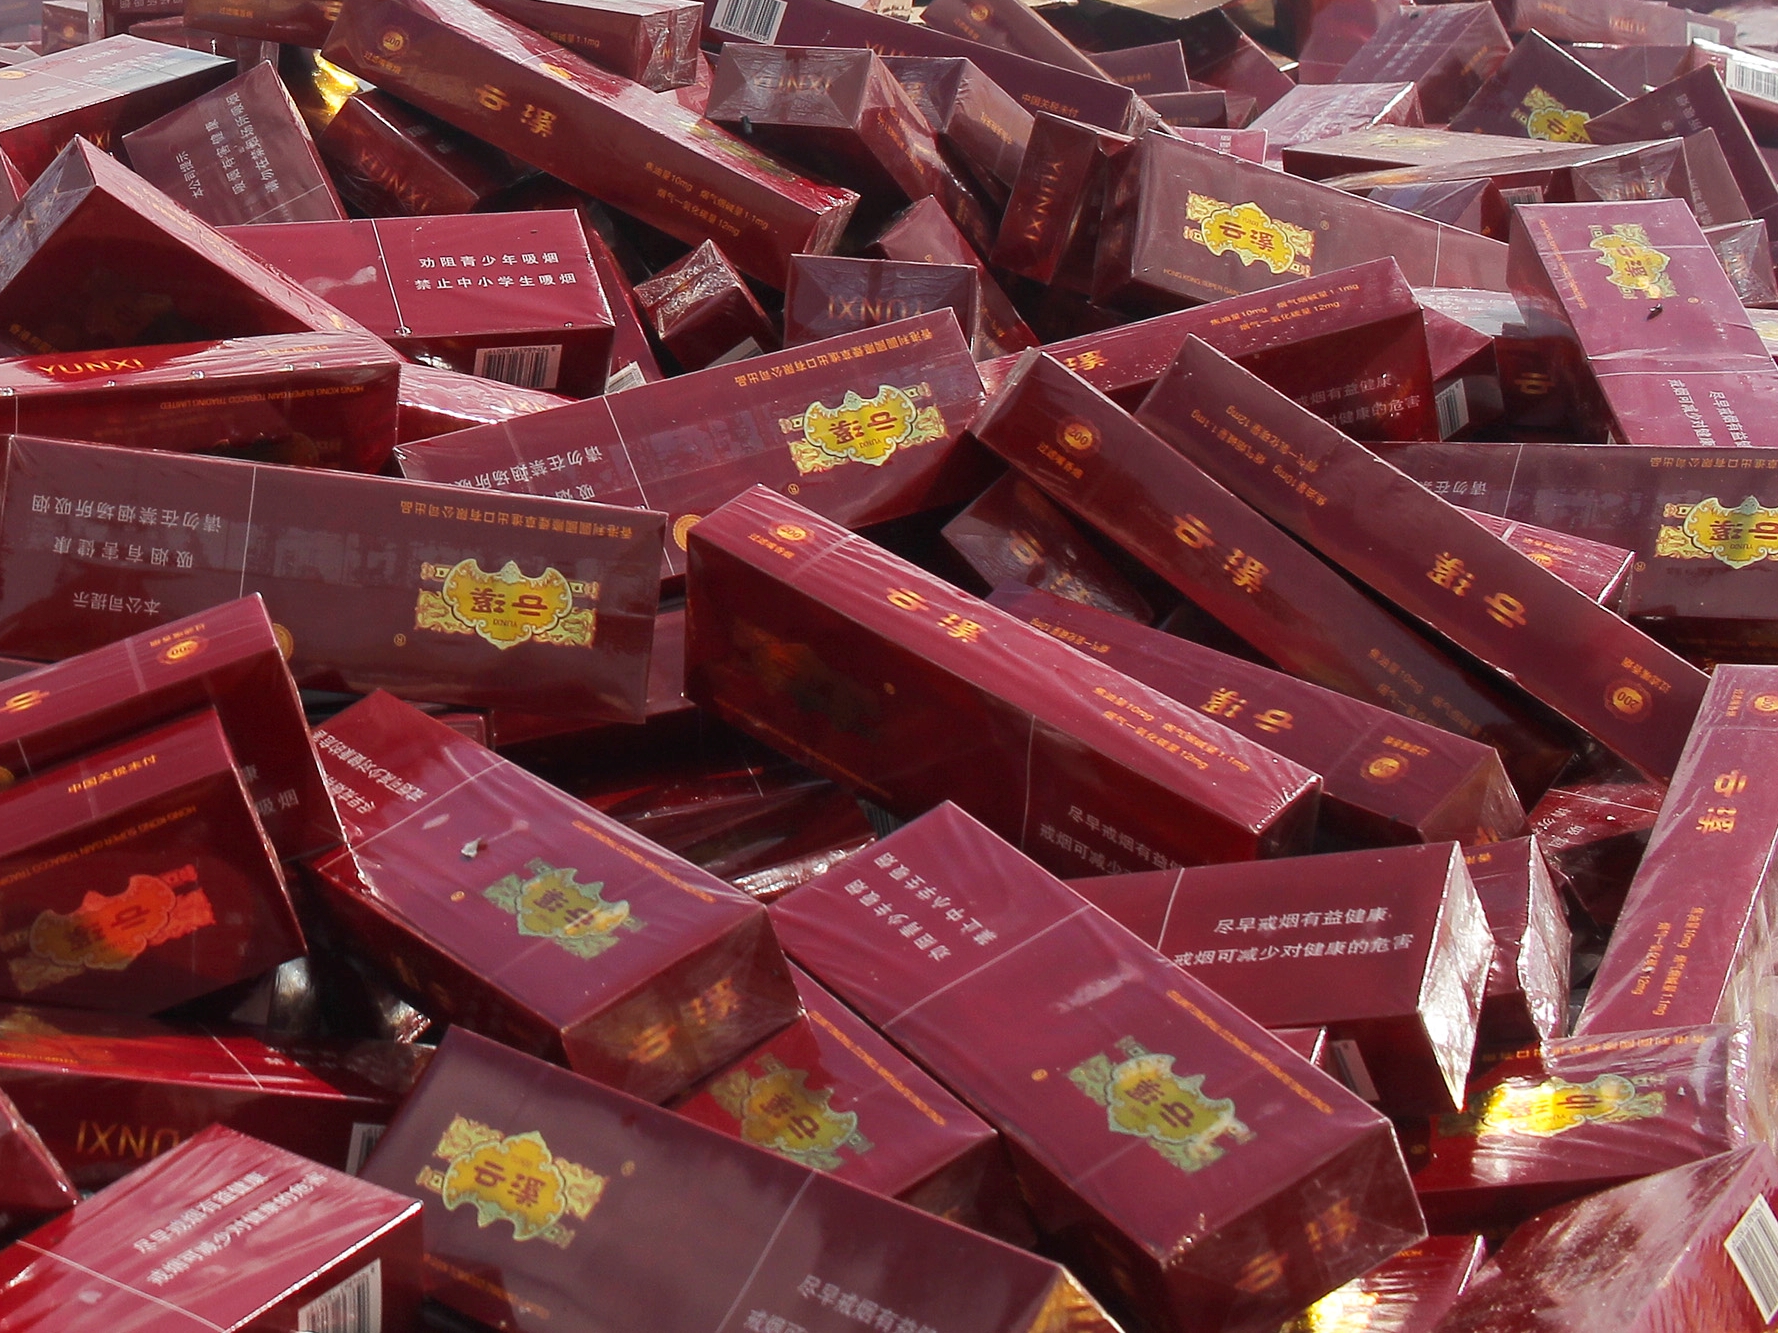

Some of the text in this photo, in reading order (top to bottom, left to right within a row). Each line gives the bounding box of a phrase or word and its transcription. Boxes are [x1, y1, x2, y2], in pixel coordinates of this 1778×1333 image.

[473, 83, 558, 139] 云溪
[205, 118, 245, 196] 吸烟有害健康
[224, 90, 280, 196] 请勿在禁烟场所吸烟
[174, 149, 205, 200] 本公司提示
[1026, 160, 1062, 243] YUNXI
[418, 251, 560, 270] 劝阻青少年吸烟
[1218, 221, 1277, 253] 云溪
[414, 270, 578, 292] 禁止中小学生吸烟
[36, 356, 146, 378] YUNXI
[828, 409, 901, 446] 云溪
[1070, 427, 1090, 448] 200
[30, 492, 223, 535] 请勿在禁烟场所吸烟
[52, 534, 194, 569] 吸烟有害健康
[1171, 513, 1272, 594] 云溪
[71, 590, 162, 615] 本公司提示
[468, 586, 550, 619] 云溪
[1425, 551, 1527, 629] 云溪
[885, 586, 988, 644] 云溪
[1198, 686, 1295, 735] 云溪
[1616, 690, 1639, 710] 200
[66, 752, 159, 795] 中国关税未付
[1695, 768, 1749, 835] 云溪
[843, 877, 952, 963] 劝阻青少年吸烟
[873, 850, 999, 948] 禁止中小学生吸烟
[1213, 905, 1392, 935] 尽早戒烟有益健康
[1172, 932, 1416, 968] 戒烟可减少对健康的危害
[1123, 1078, 1196, 1131] 云溪
[472, 1159, 548, 1209] 云溪
[133, 1170, 270, 1255] 尽早戒烟有益健康
[146, 1170, 328, 1289] 戒烟可减少对健康的危害
